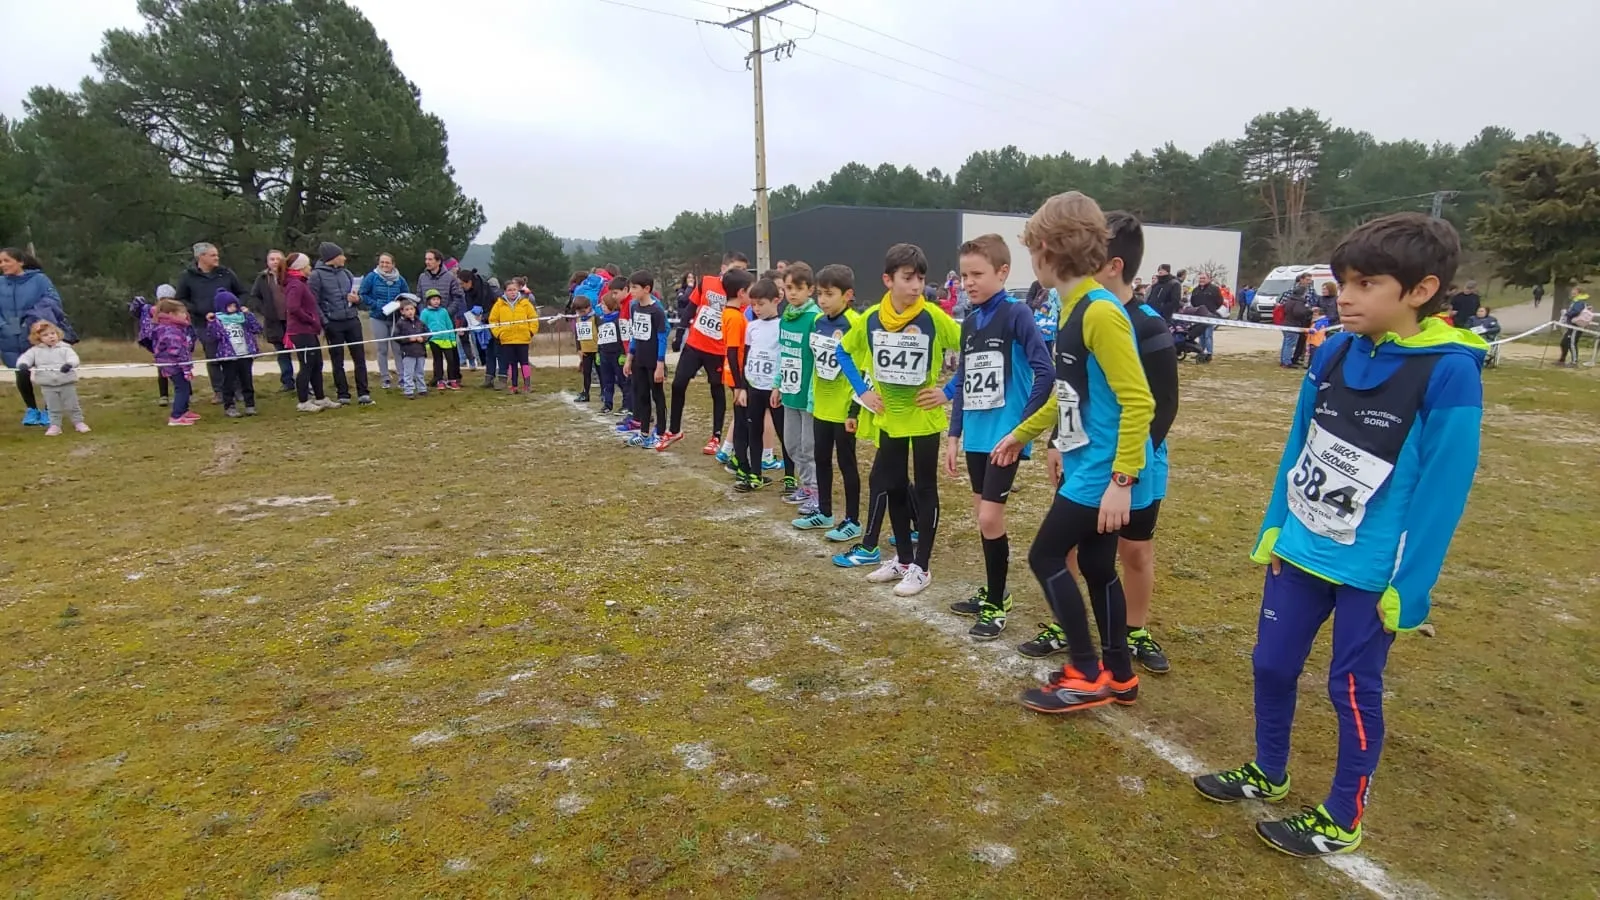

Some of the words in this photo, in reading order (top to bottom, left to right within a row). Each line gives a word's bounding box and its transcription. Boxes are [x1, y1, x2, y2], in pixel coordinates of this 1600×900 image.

[877, 349, 924, 370] 647
[1364, 417, 1389, 428] SORIA
[1330, 442, 1361, 462] JUEGOS
[1293, 453, 1358, 519] 584
